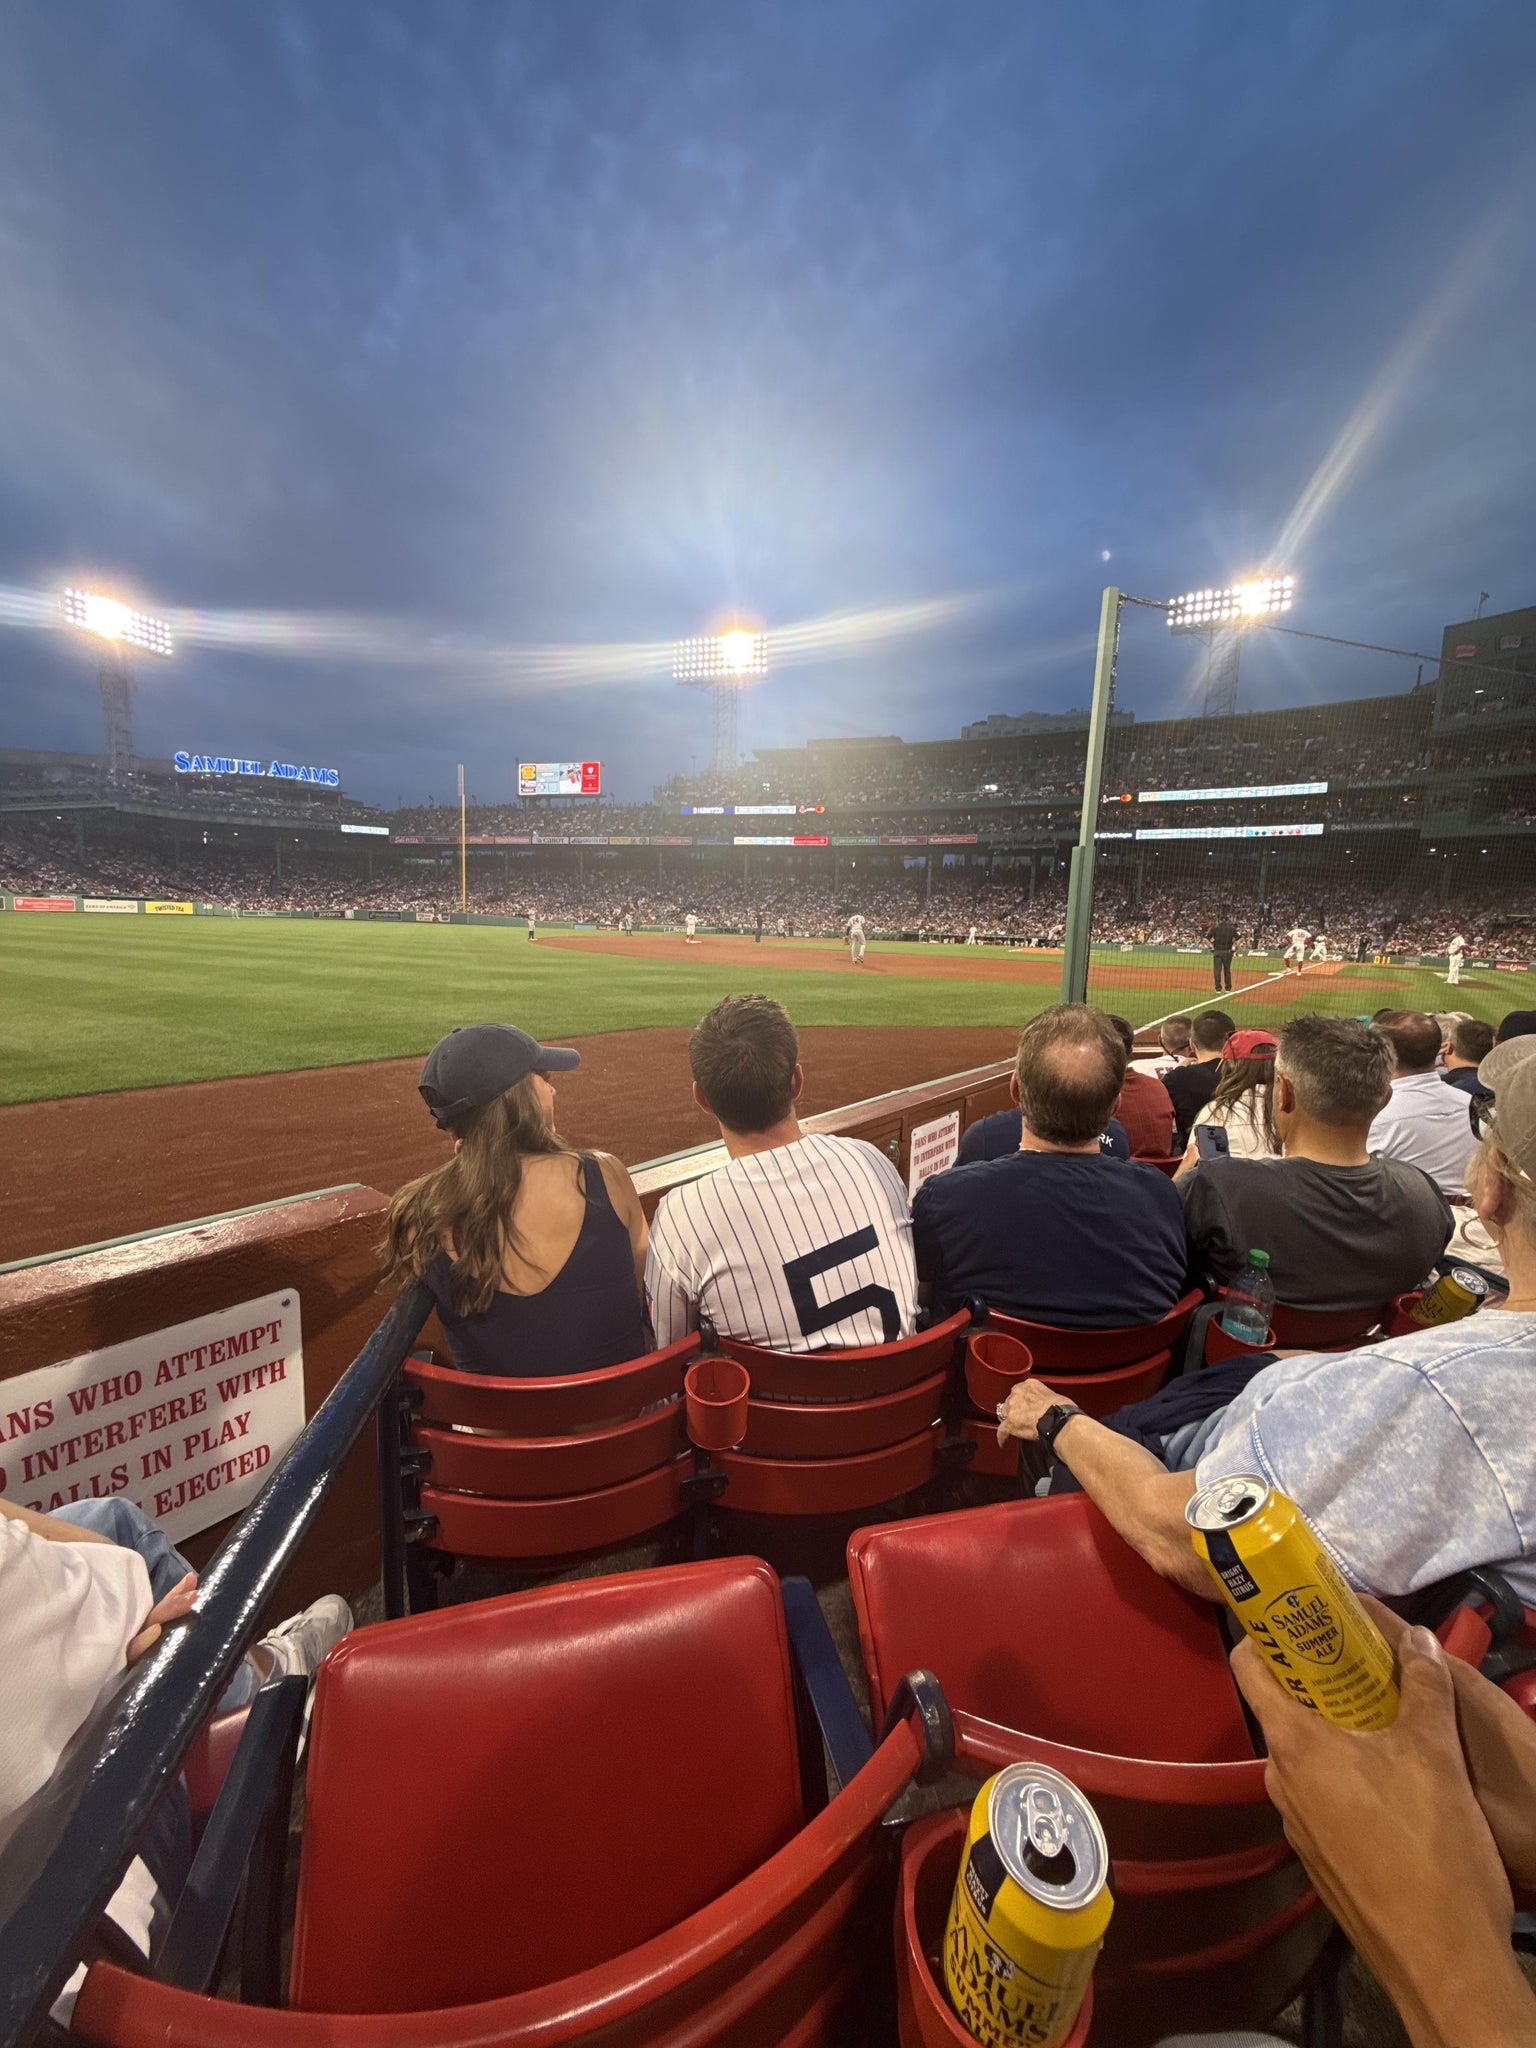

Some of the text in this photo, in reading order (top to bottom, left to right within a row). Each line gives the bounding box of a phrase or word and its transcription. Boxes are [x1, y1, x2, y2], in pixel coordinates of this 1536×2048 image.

[174, 751, 340, 786] SAMUEL ADAMS
[914, 1136, 927, 1149] FANS
[1099, 1133, 1114, 1149] RK
[913, 1155, 920, 1166] TO
[919, 1155, 950, 1179] BALLS IN PLAY
[783, 1224, 901, 1350] 5
[0, 1320, 282, 1444] NS WHO ATTEMPT
[21, 1358, 287, 1483] INTERFERE WITH
[140, 1444, 173, 1480] IN
[183, 1411, 252, 1462] PLAY
[154, 1444, 271, 1518] EJECTED
[1227, 1574, 1248, 1590] HAZY
[1231, 1582, 1255, 1598] CITRUS
[1271, 1595, 1329, 1630] SAMUEL
[1286, 1610, 1334, 1644] ADAMS
[1296, 1627, 1340, 1653] SUMMER
[1315, 1644, 1336, 1660] ALE
